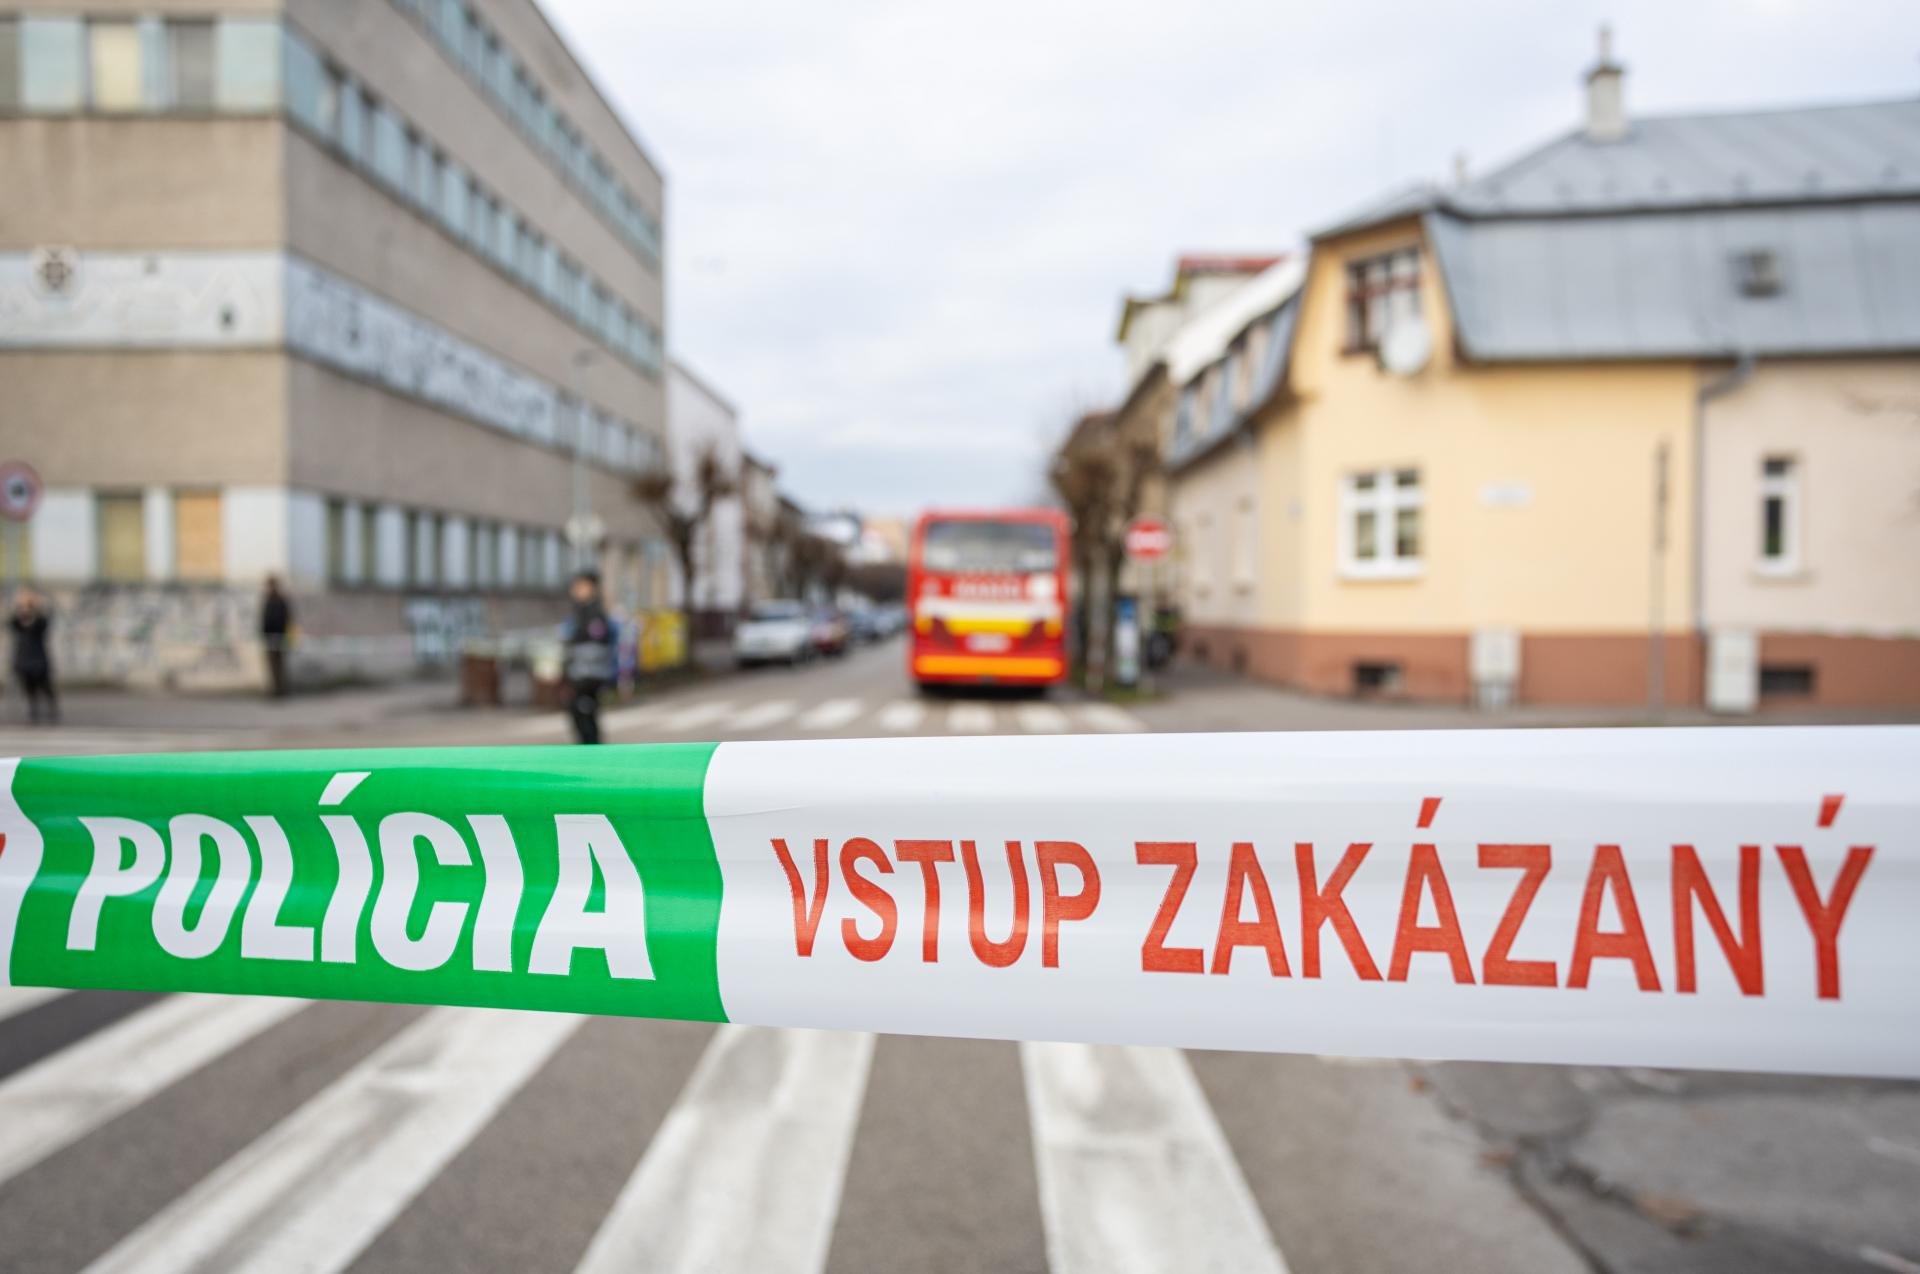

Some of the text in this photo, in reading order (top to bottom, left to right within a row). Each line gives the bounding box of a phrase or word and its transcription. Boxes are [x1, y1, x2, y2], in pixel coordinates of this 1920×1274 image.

[67, 771, 1875, 1001] POLÍCIA VSTUP ZAKÁZANÝ
